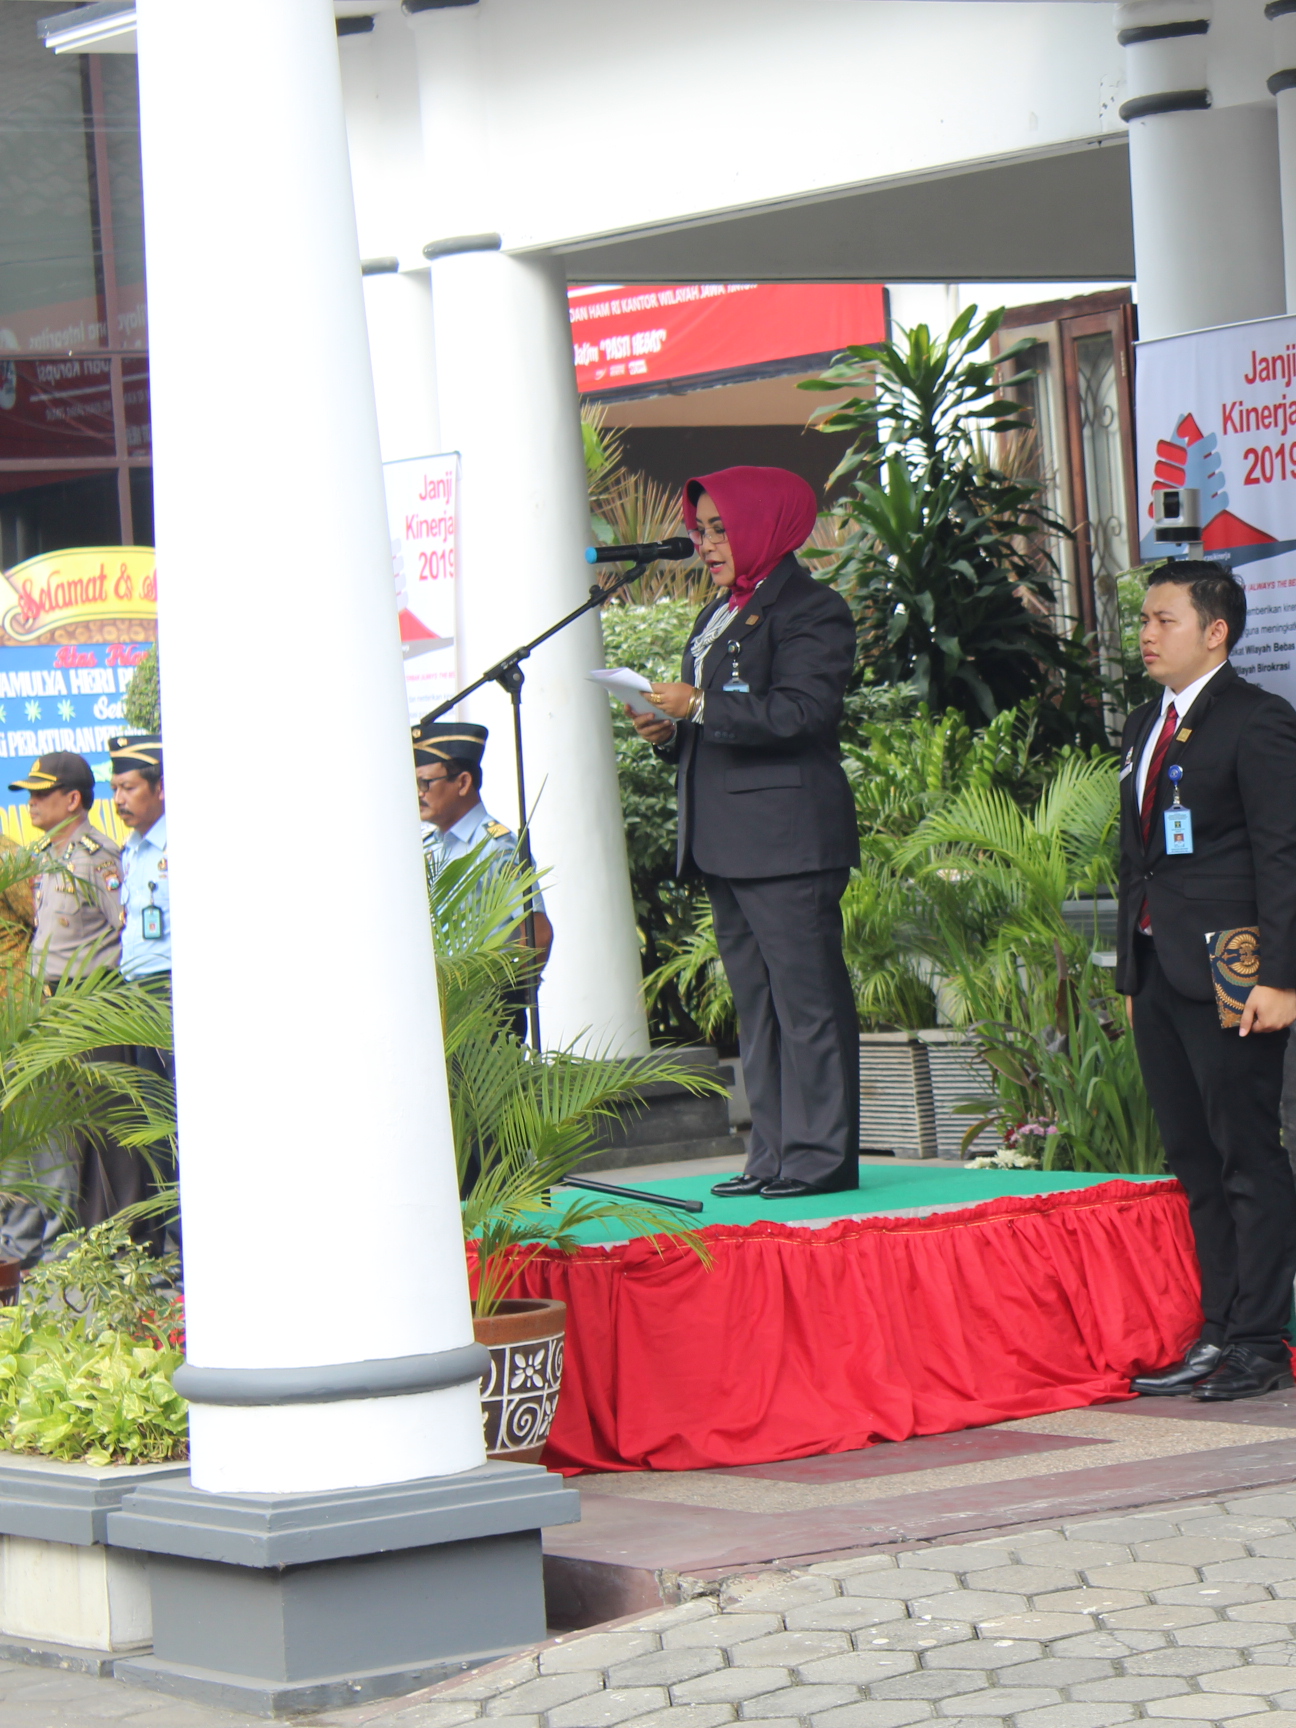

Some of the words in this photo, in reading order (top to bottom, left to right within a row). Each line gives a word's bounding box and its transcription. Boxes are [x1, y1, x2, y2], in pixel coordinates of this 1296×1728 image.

[588, 302, 611, 319] HAM
[611, 299, 621, 316] RI
[621, 292, 659, 313] KANTOR
[658, 285, 700, 306] WILAYAH
[700, 284, 727, 299] JAWA
[1244, 343, 1296, 388] Janji
[419, 470, 453, 505] Janji
[405, 510, 454, 543] Kinerja
[18, 563, 108, 622] Selamat
[69, 667, 116, 695] HERI
[8, 727, 95, 758] PERATURAN
